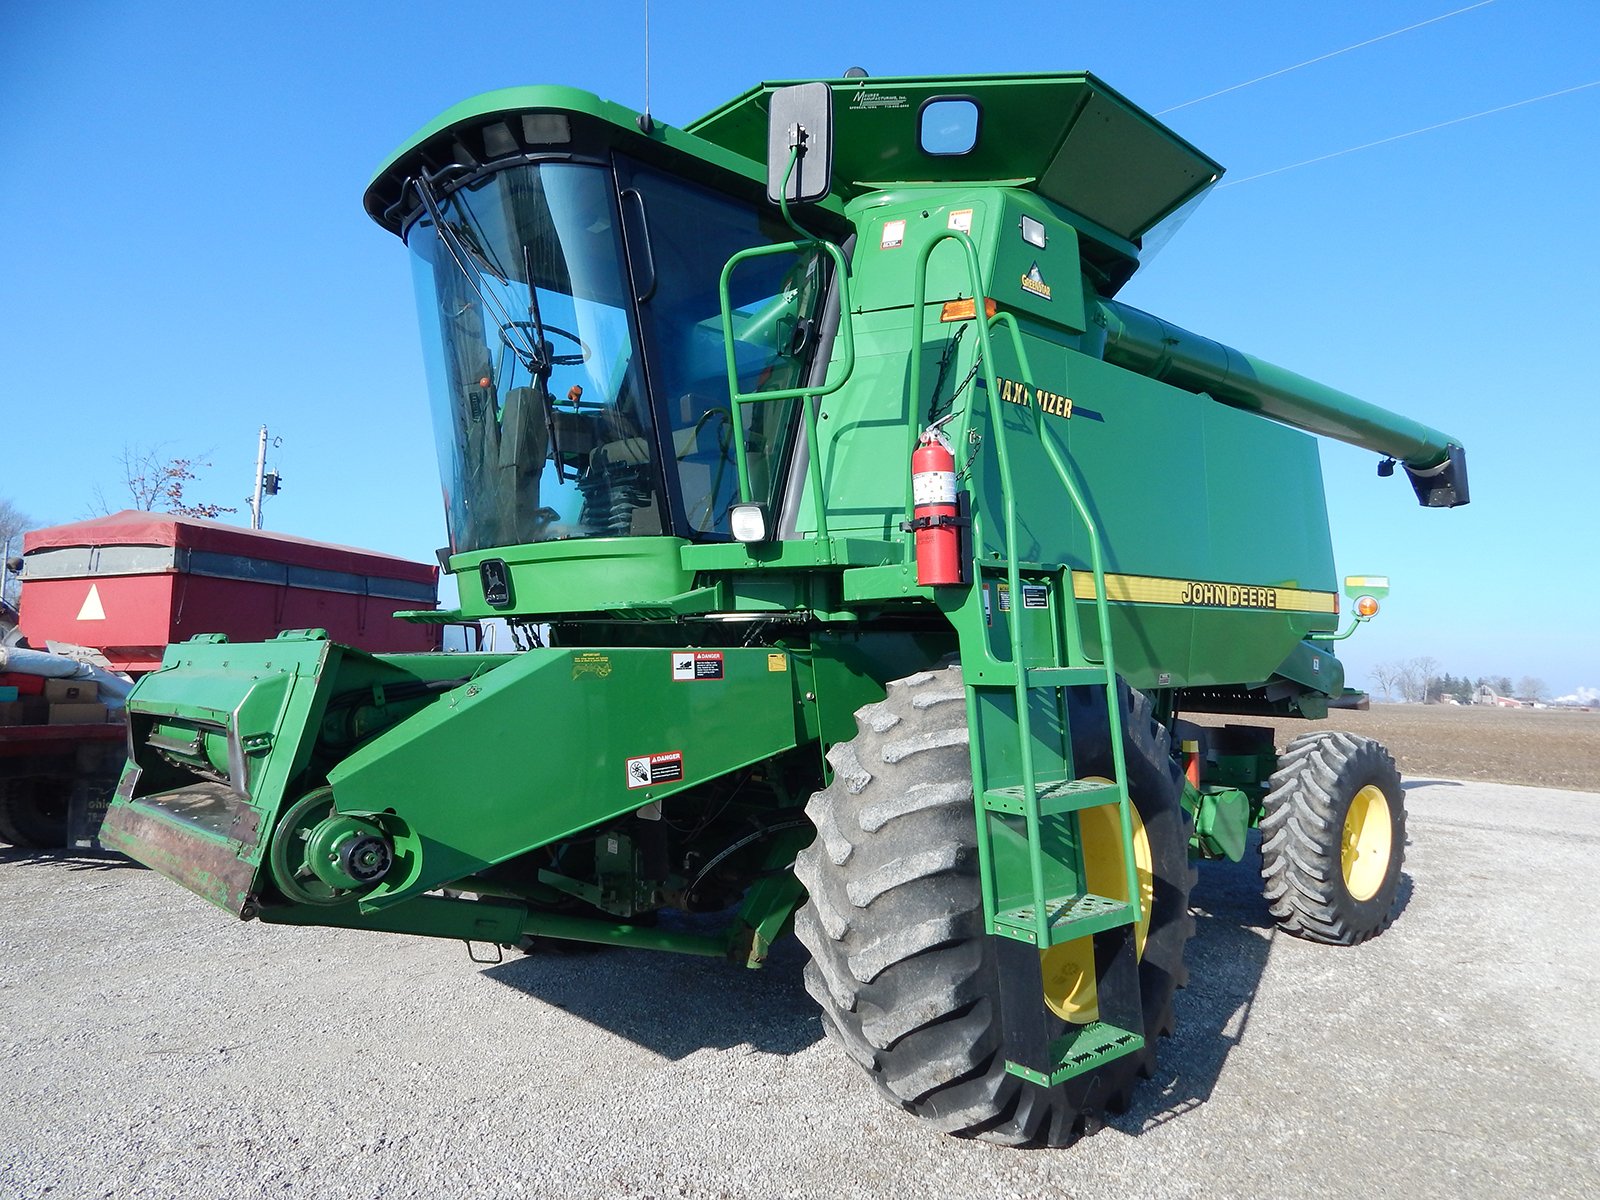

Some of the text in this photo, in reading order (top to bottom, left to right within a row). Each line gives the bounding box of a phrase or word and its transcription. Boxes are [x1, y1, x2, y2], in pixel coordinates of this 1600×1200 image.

[1182, 583, 1276, 608] JOHN DEERE
[656, 753, 680, 762] DANGER
